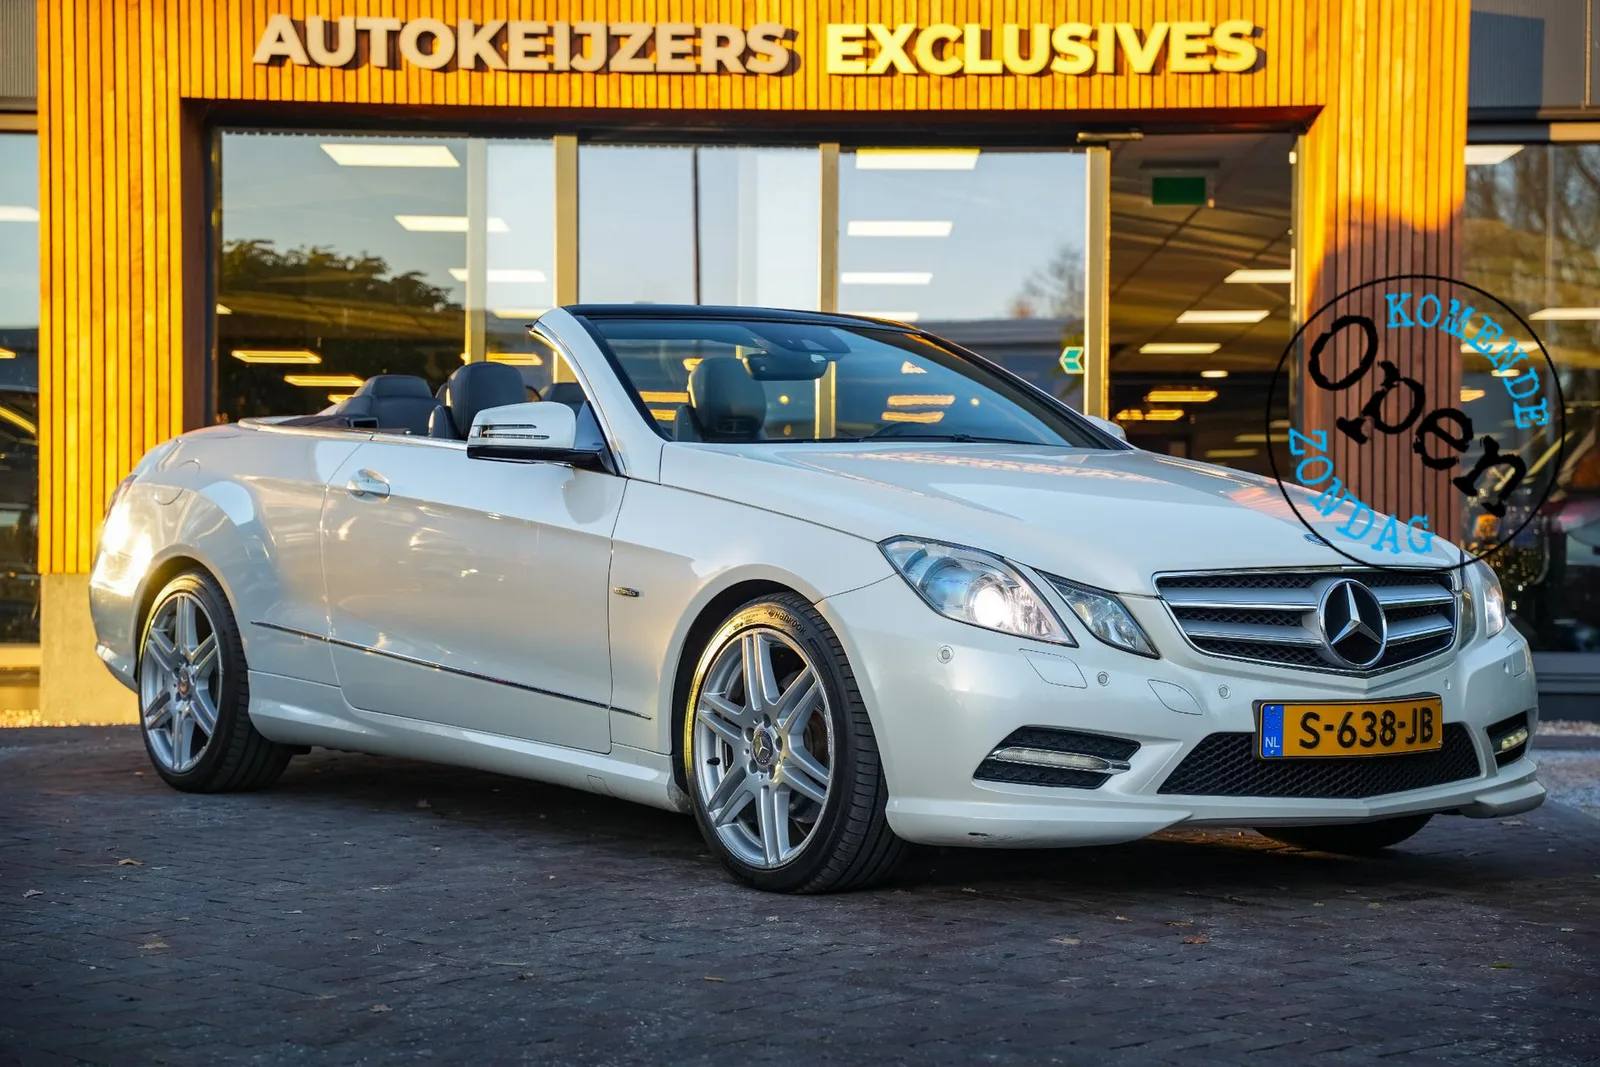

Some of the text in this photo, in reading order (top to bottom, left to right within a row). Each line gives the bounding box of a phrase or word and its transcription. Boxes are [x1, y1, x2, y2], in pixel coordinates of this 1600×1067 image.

[252, 13, 1260, 76] AUTOKEIJZERS EXCLUSIVES
[1265, 706, 1433, 749] NL S-638-JB
